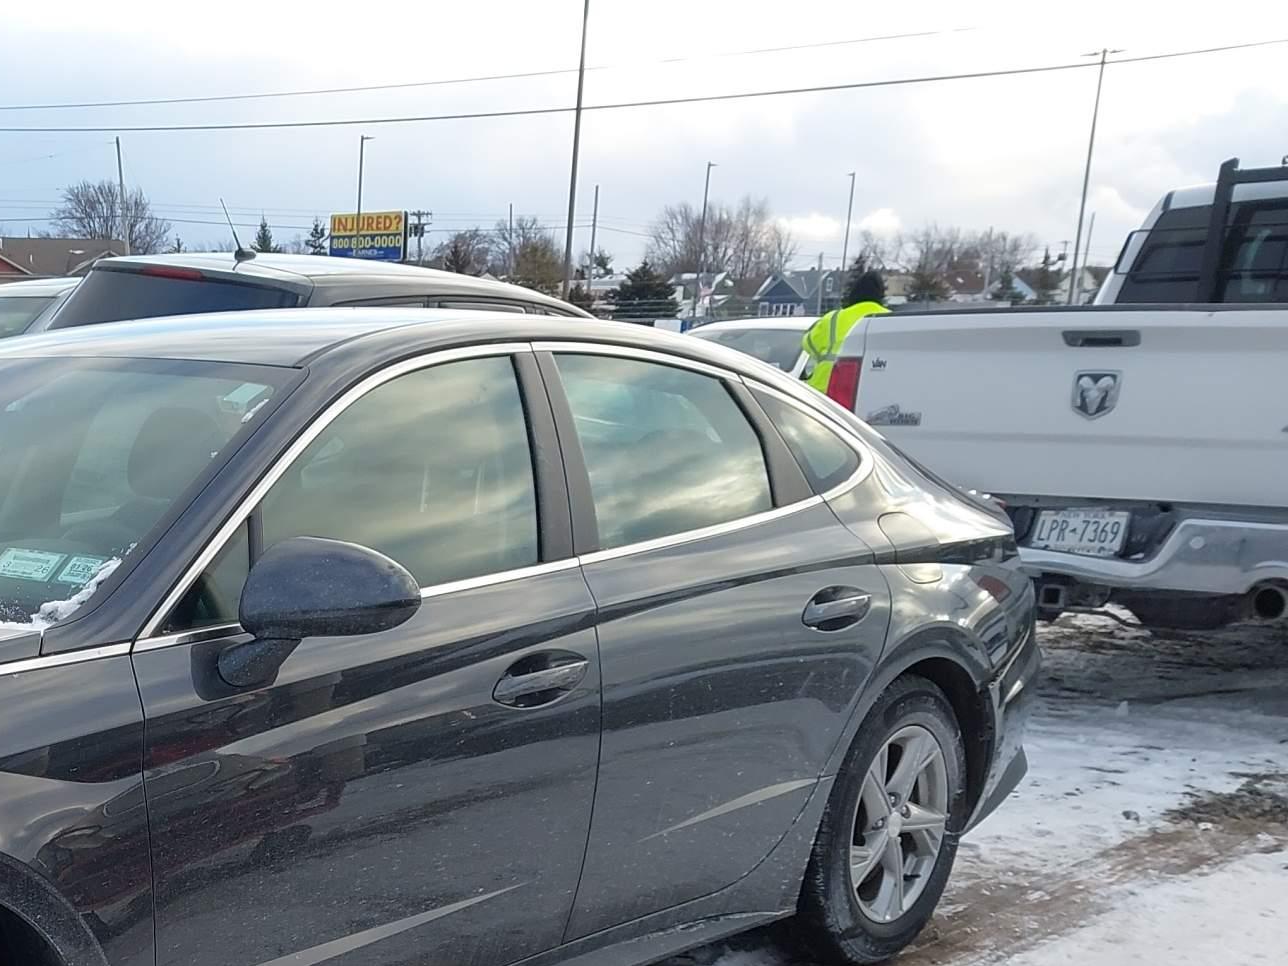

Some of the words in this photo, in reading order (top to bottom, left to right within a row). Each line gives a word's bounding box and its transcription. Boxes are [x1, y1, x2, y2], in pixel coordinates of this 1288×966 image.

[332, 215, 402, 233] INJURED?
[333, 238, 349, 249] 800
[351, 235, 402, 249] 800-0000
